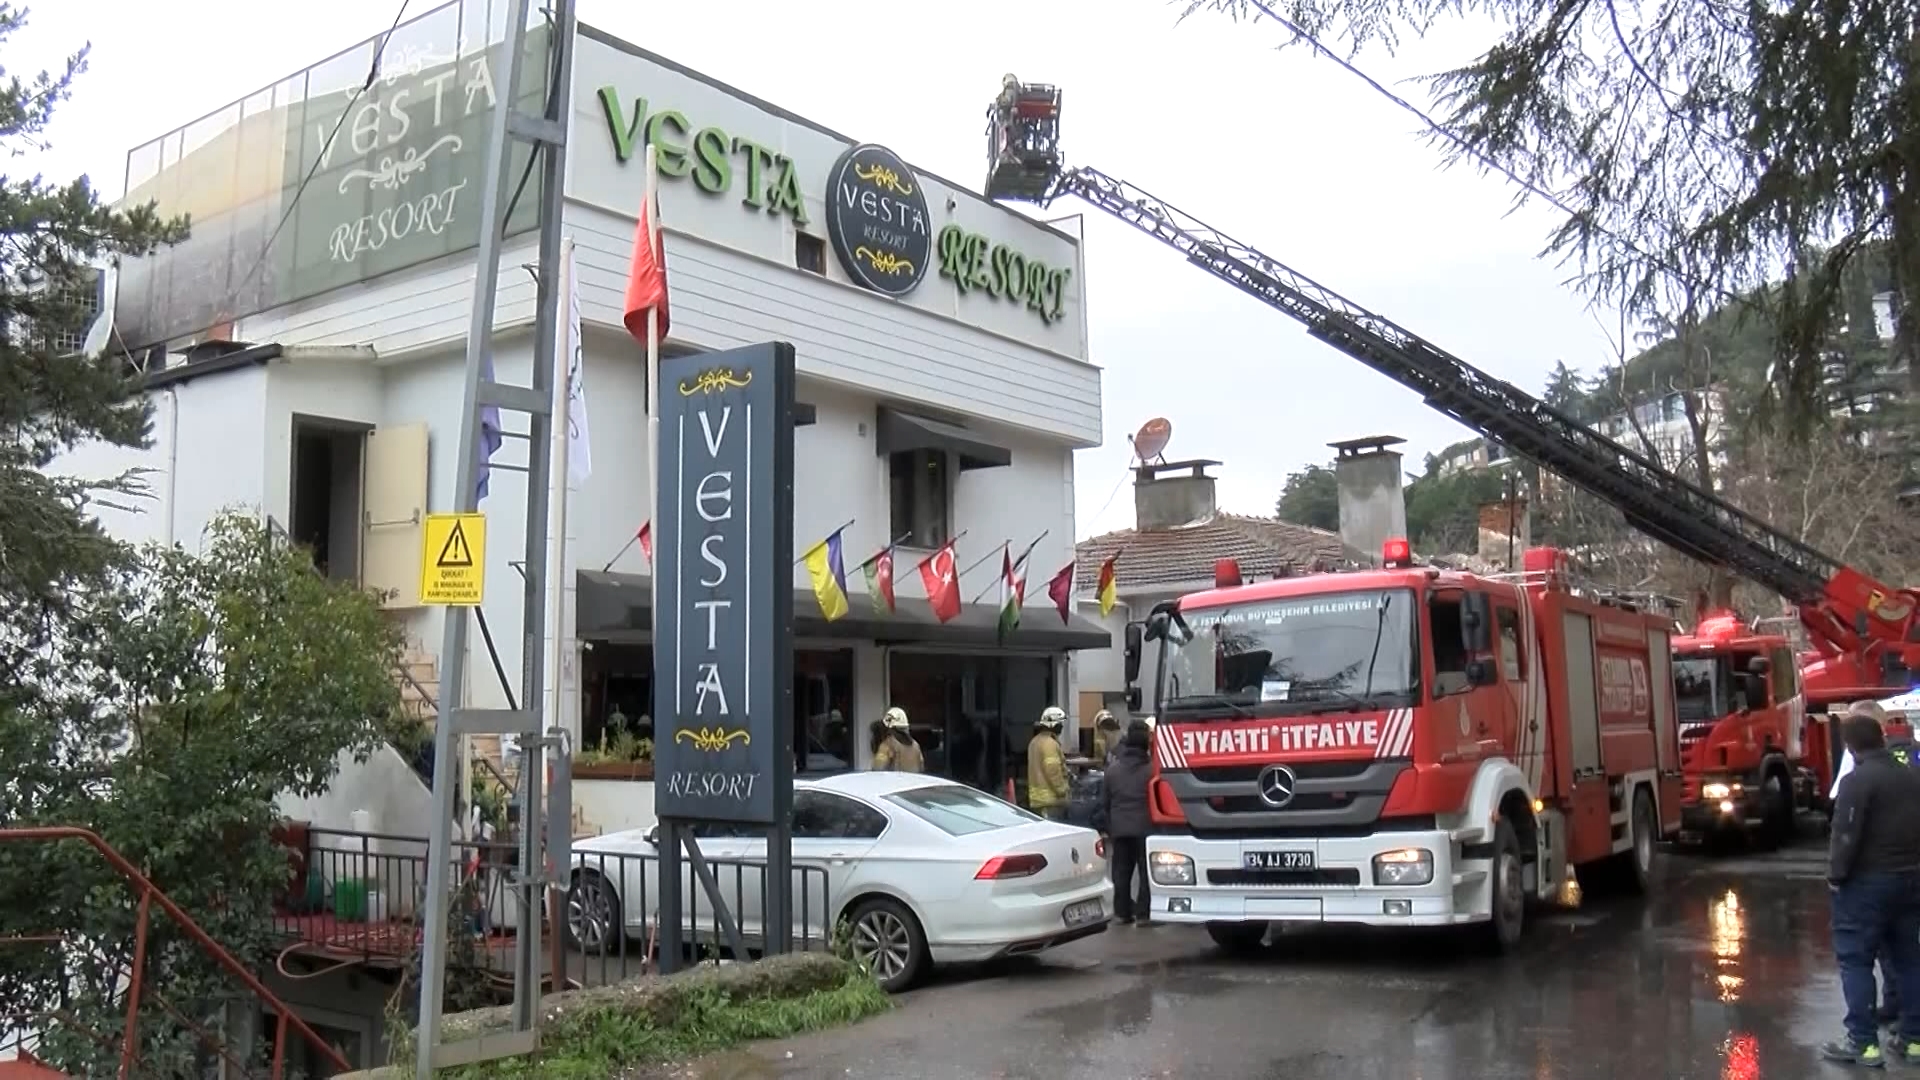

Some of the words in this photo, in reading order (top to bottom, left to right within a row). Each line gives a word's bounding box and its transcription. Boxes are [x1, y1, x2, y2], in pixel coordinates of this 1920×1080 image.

[317, 56, 497, 169] VESTA
[329, 178, 467, 262] RESORT
[598, 86, 809, 226] VESTA
[938, 222, 1072, 325] RESORT
[843, 183, 925, 236] VESTA
[863, 224, 910, 249] RESORT
[695, 406, 731, 715] VESTA
[666, 771, 759, 800] RESORT
[1250, 853, 1263, 867] 34
[1267, 853, 1280, 867] AJ
[1284, 853, 1311, 867] 3730
